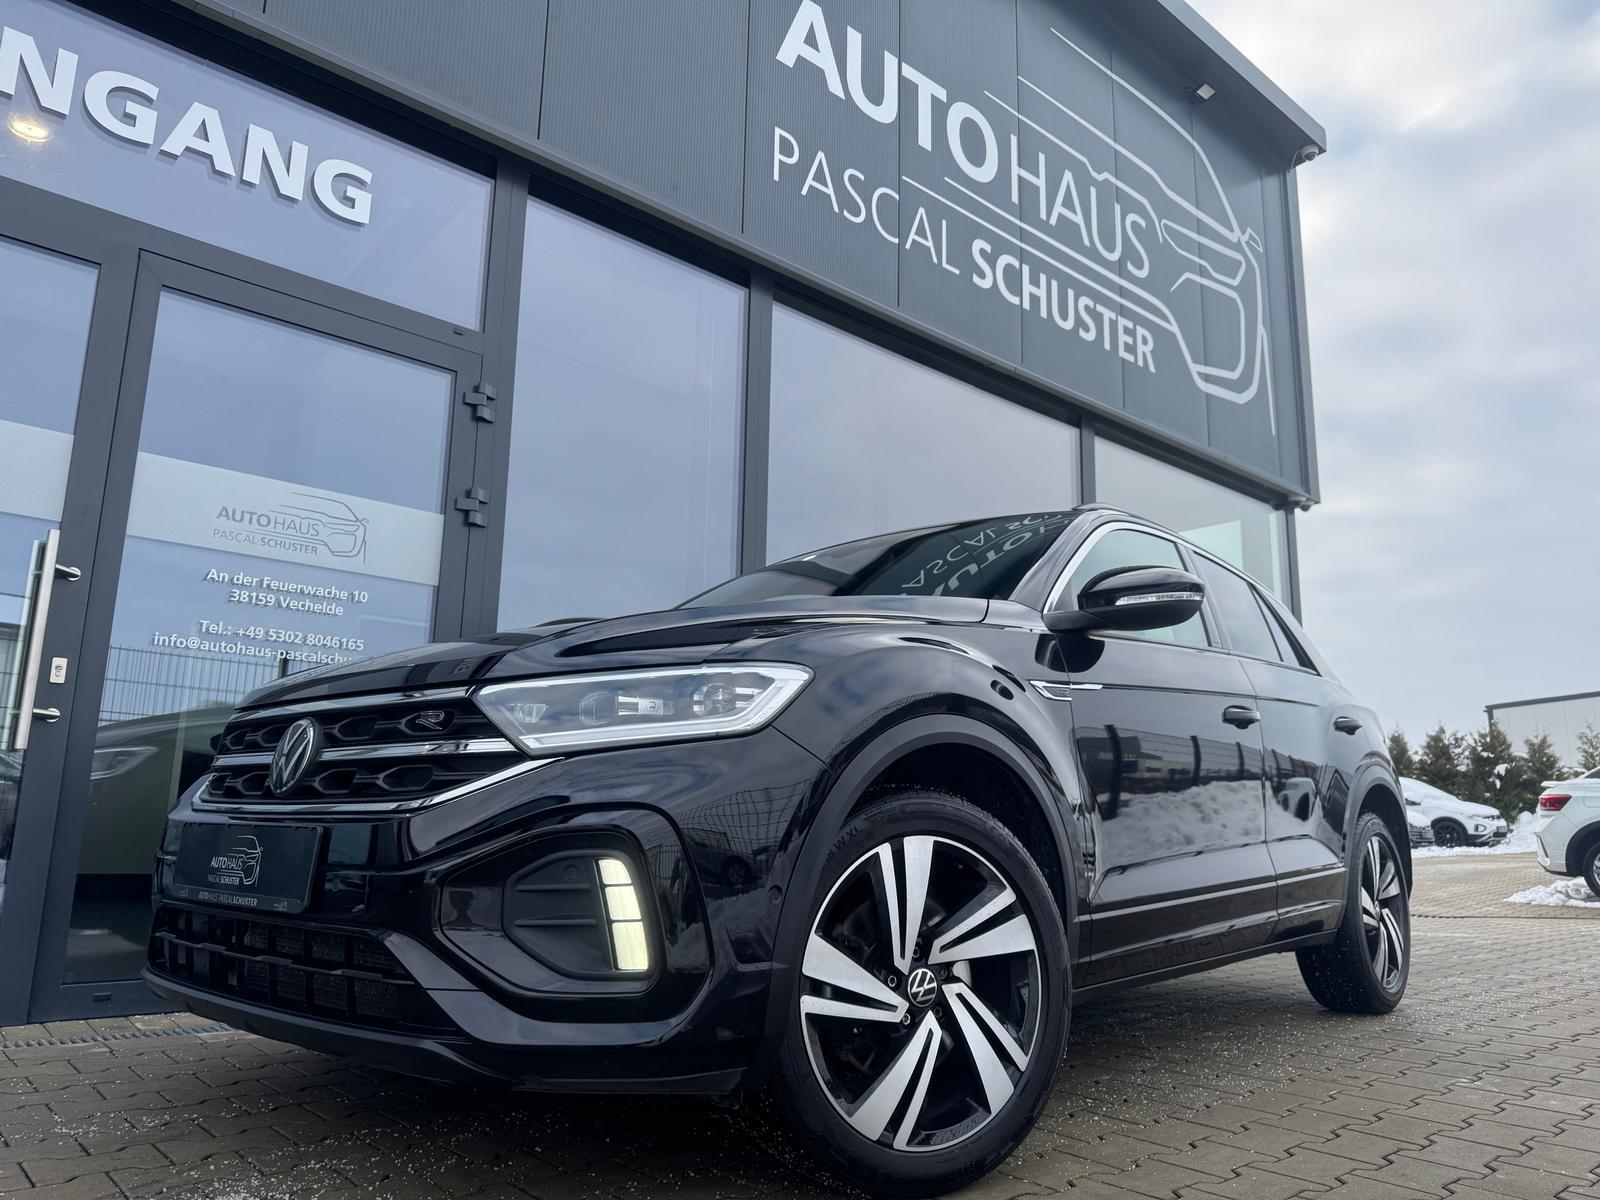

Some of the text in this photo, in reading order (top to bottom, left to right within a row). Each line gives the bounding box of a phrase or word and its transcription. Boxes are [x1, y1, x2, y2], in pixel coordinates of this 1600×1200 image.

[0, 26, 373, 225] NGANG
[773, 126, 1156, 374] PASCAL SCHUSTER
[212, 528, 319, 556] PASCAL SCHUSTER
[206, 568, 368, 603] An der Feuerwache 10
[230, 590, 344, 616] 38159 Vechelde
[200, 620, 364, 651] Tel.: +49 5302 8046165
[232, 895, 258, 907] SCHUSTER
